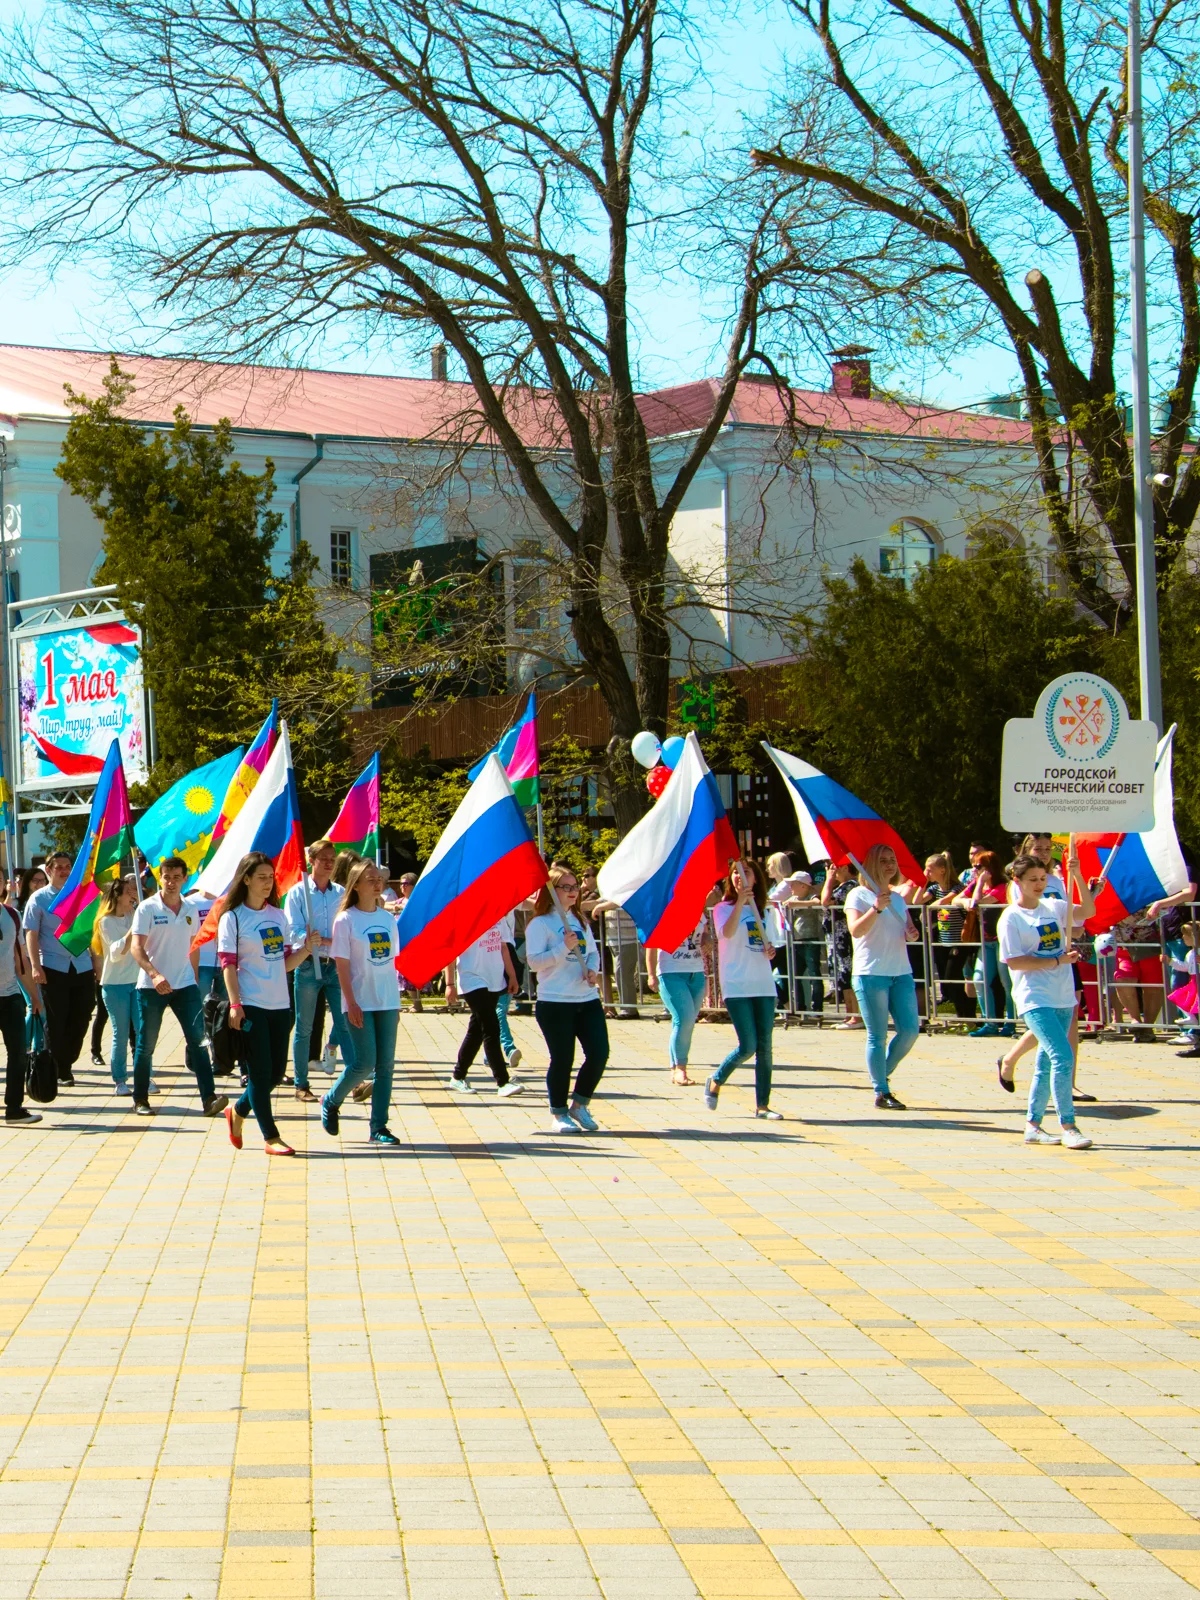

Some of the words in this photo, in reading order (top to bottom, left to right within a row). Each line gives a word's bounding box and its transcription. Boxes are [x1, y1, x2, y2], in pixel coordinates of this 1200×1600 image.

[43, 651, 57, 706] 1
[66, 670, 119, 705] мая
[38, 717, 63, 741] Мир,
[65, 716, 94, 738] труд,
[97, 709, 123, 728] май!
[1044, 766, 1116, 781] ГОРОДСКОЙ
[1013, 780, 1105, 795] СТУДЕНЧЕСКИЙ
[1108, 783, 1145, 794] СОВЕТ
[1030, 797, 1084, 806] Муниципального
[1085, 796, 1127, 806] образования
